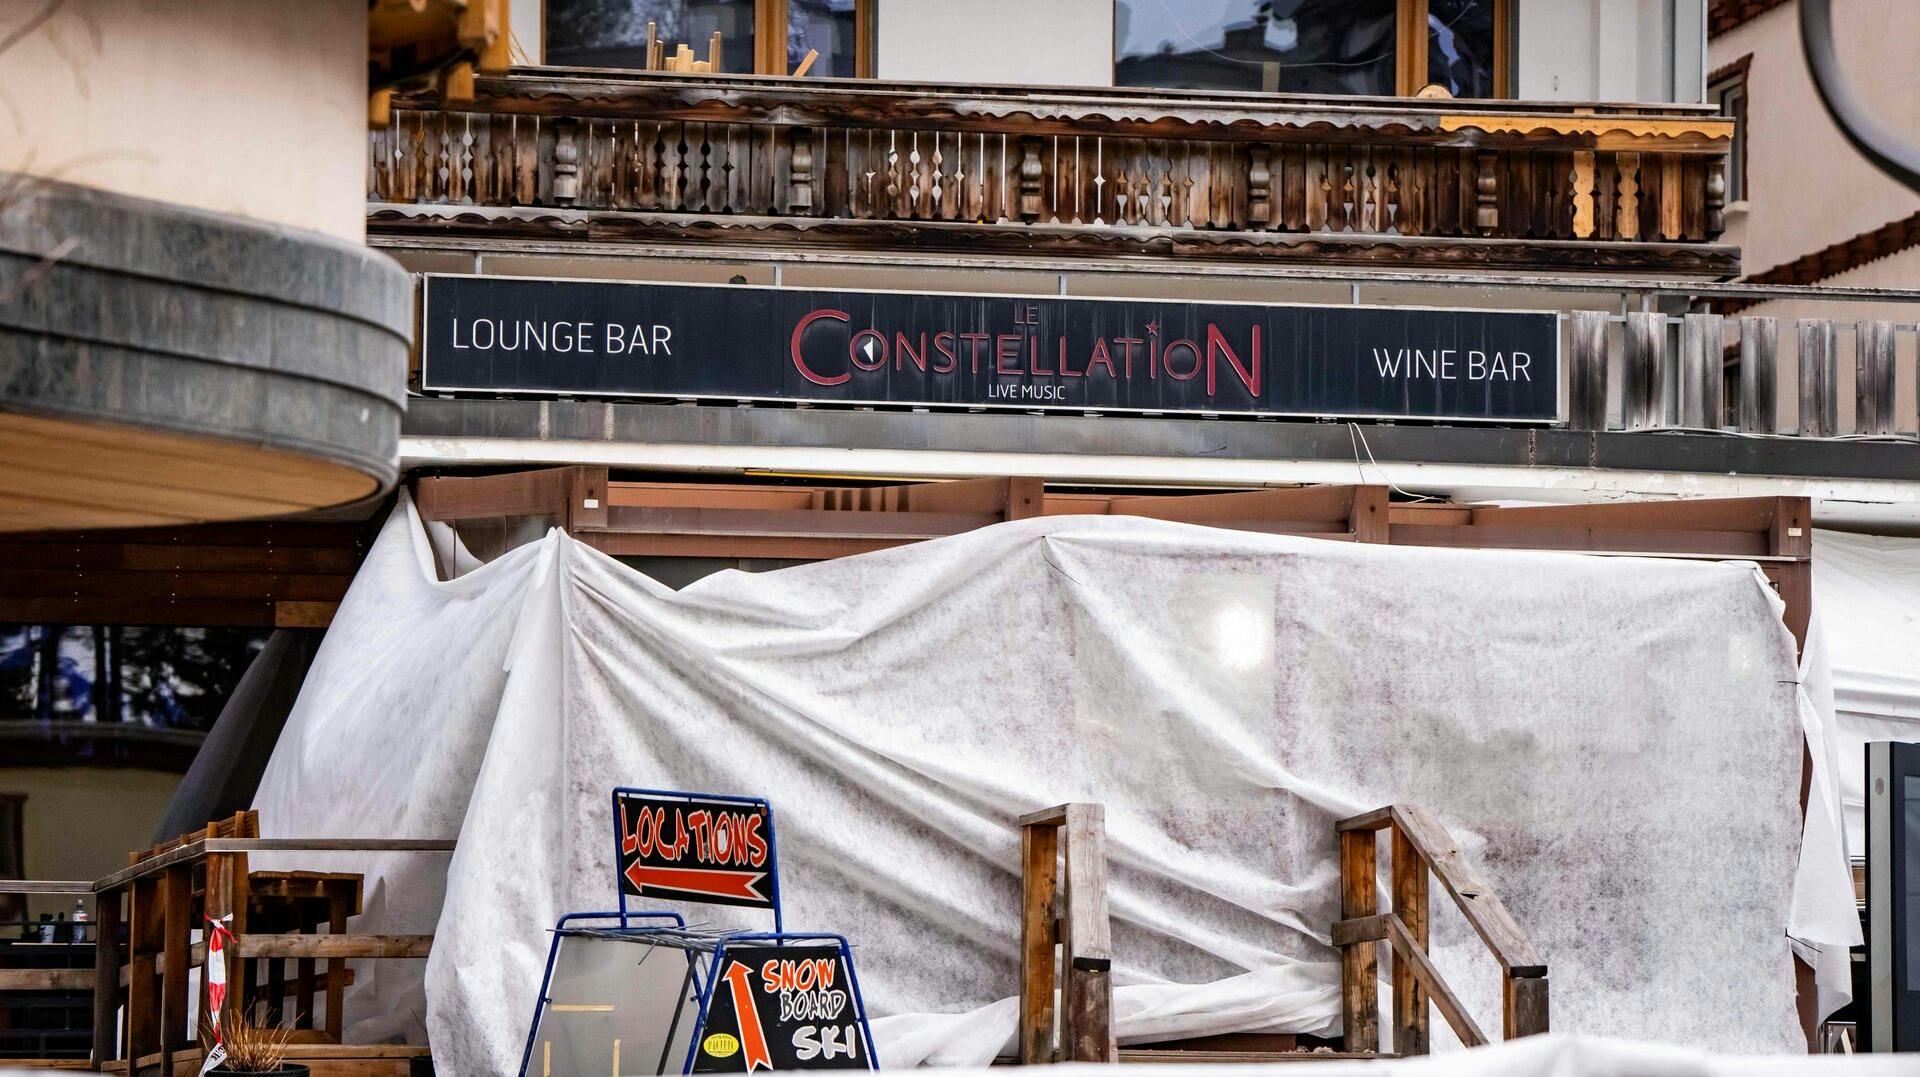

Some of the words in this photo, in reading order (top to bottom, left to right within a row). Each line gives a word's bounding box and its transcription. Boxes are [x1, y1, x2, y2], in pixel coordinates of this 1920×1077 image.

[1015, 303, 1039, 324] LE
[452, 318, 594, 353] LOUNGE
[606, 324, 673, 356] BAR
[1373, 347, 1456, 380] WINE
[1469, 350, 1532, 382] BAR
[988, 384, 1017, 398] LIVE
[1021, 385, 1066, 400] MUSIC
[620, 803, 768, 867] LOCATIONS
[761, 958, 836, 994] SNOW
[779, 989, 847, 1022] BOARD
[791, 1024, 857, 1060] SKI
